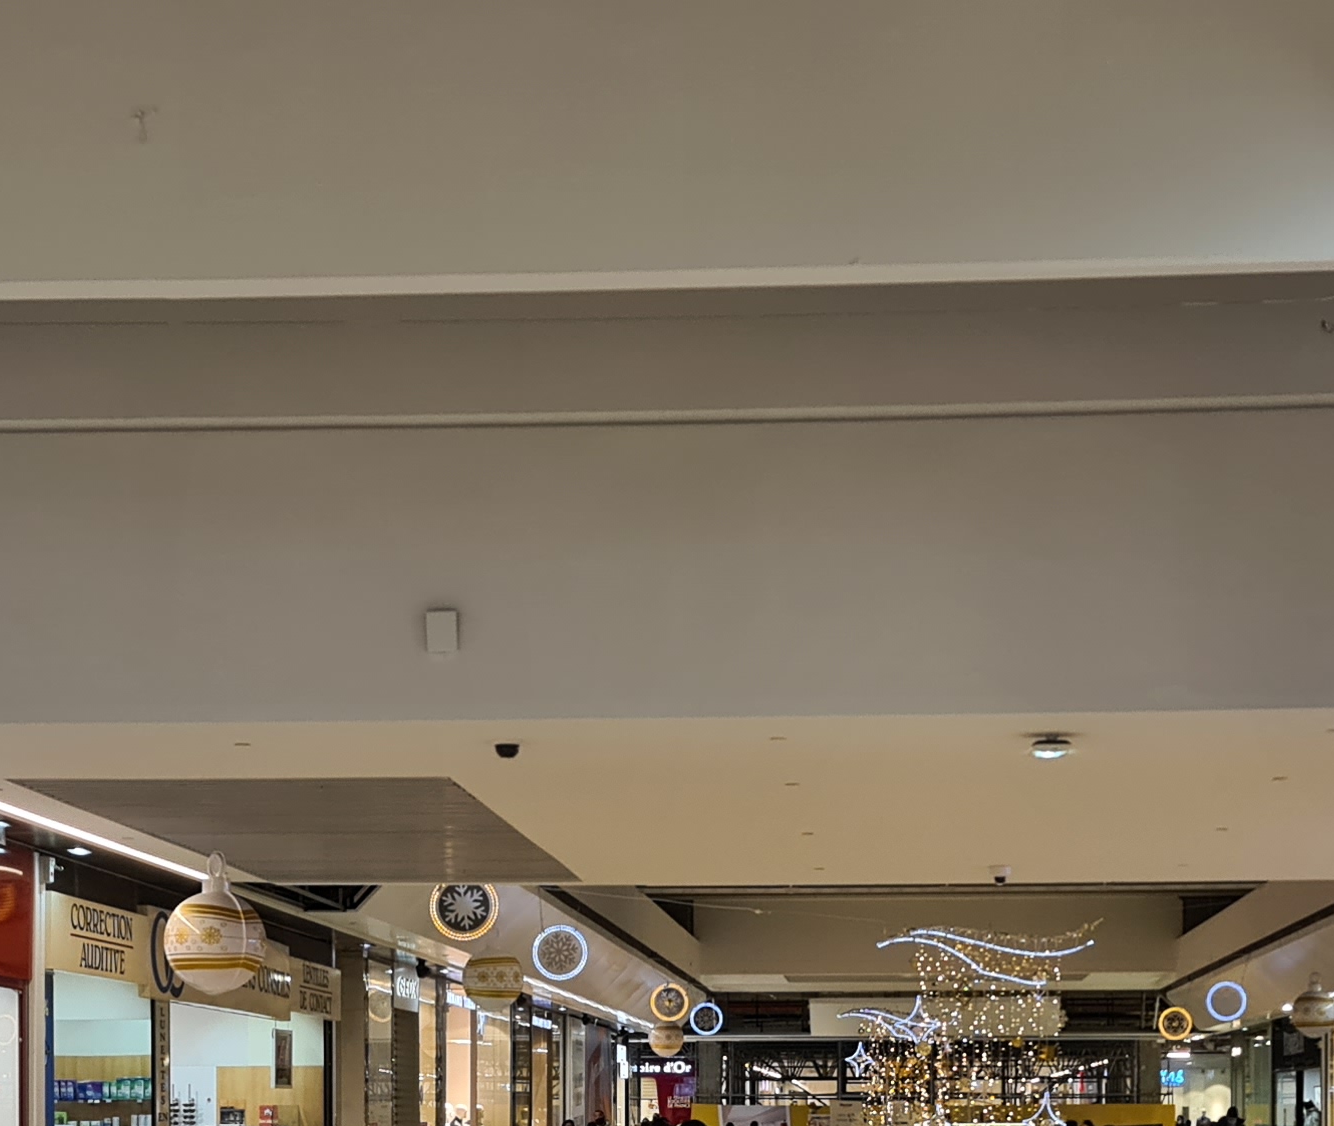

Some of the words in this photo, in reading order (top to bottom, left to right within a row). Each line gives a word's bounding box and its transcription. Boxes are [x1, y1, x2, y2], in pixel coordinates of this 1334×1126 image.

[71, 903, 133, 941] CORRECTION
[79, 942, 125, 975] AUDITIVE
[397, 975, 418, 1000] GEOX
[299, 989, 307, 1010] DE
[309, 993, 332, 1014] CONTACT
[663, 1060, 692, 1074] d'Or
